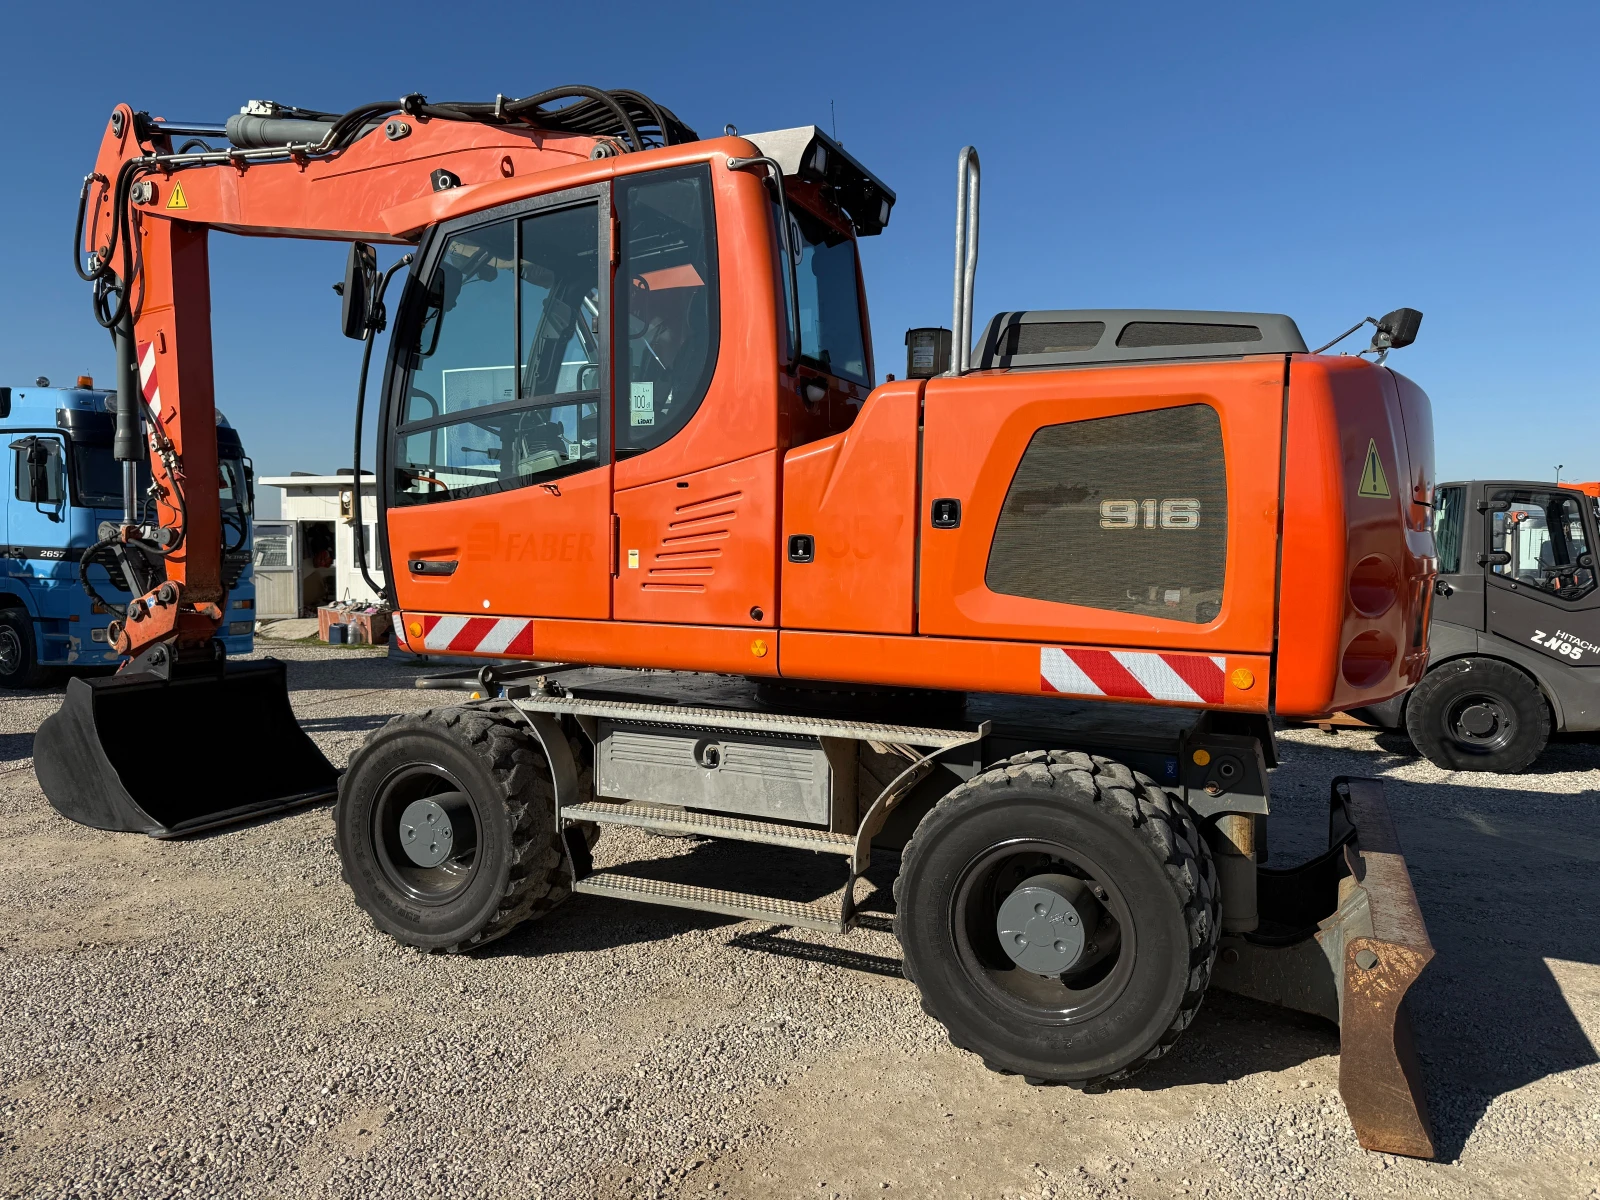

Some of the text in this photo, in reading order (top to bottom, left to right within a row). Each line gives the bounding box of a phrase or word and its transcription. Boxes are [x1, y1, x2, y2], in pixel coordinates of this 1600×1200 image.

[1099, 498, 1201, 530] 916
[40, 550, 66, 558] 2657
[504, 533, 596, 562] FABER
